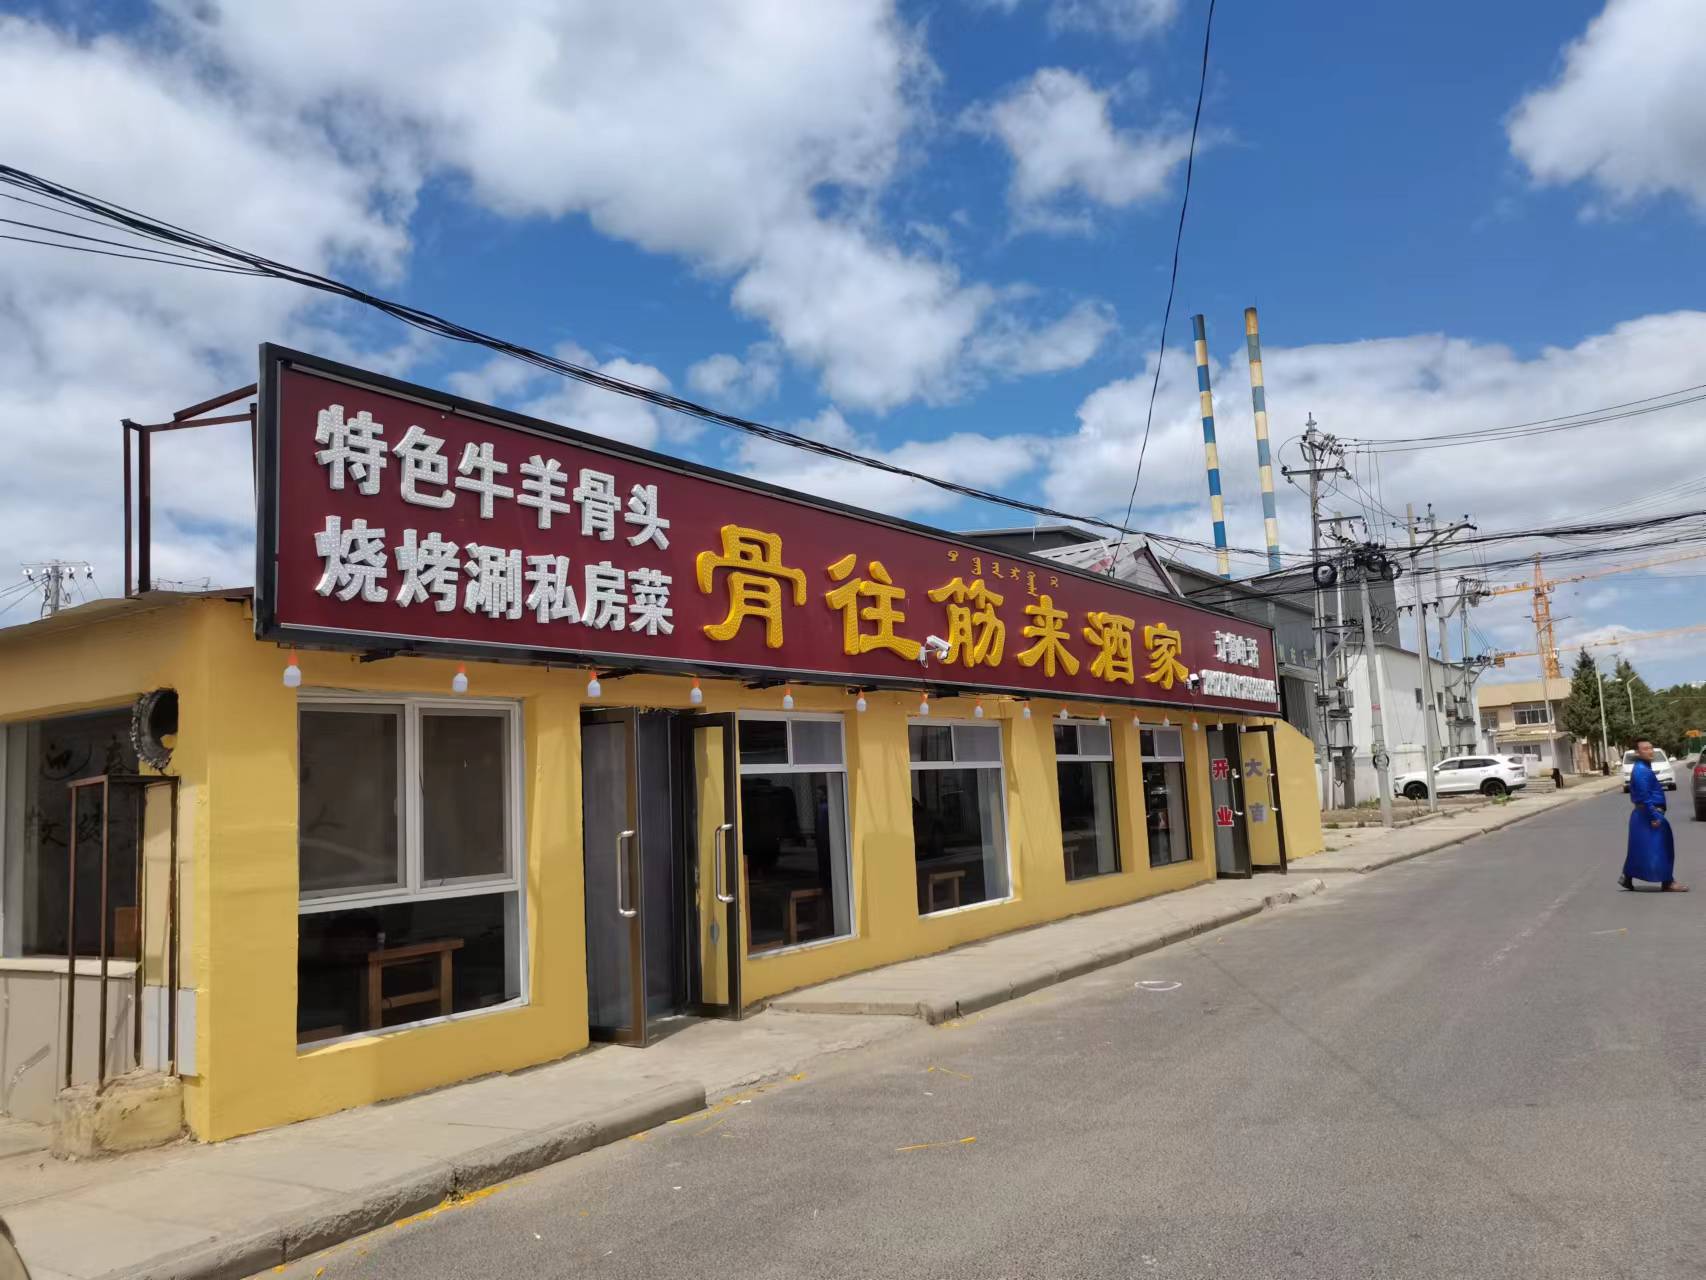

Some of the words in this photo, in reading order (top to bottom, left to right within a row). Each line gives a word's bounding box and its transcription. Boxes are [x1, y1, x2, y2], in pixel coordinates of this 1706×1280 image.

[315, 404, 670, 550] 特色牛羊骨头
[314, 515, 674, 636] 烧烤涮私房菜
[696, 524, 1189, 690] 骨往筋来酒家
[1211, 758, 1235, 827] 开业
